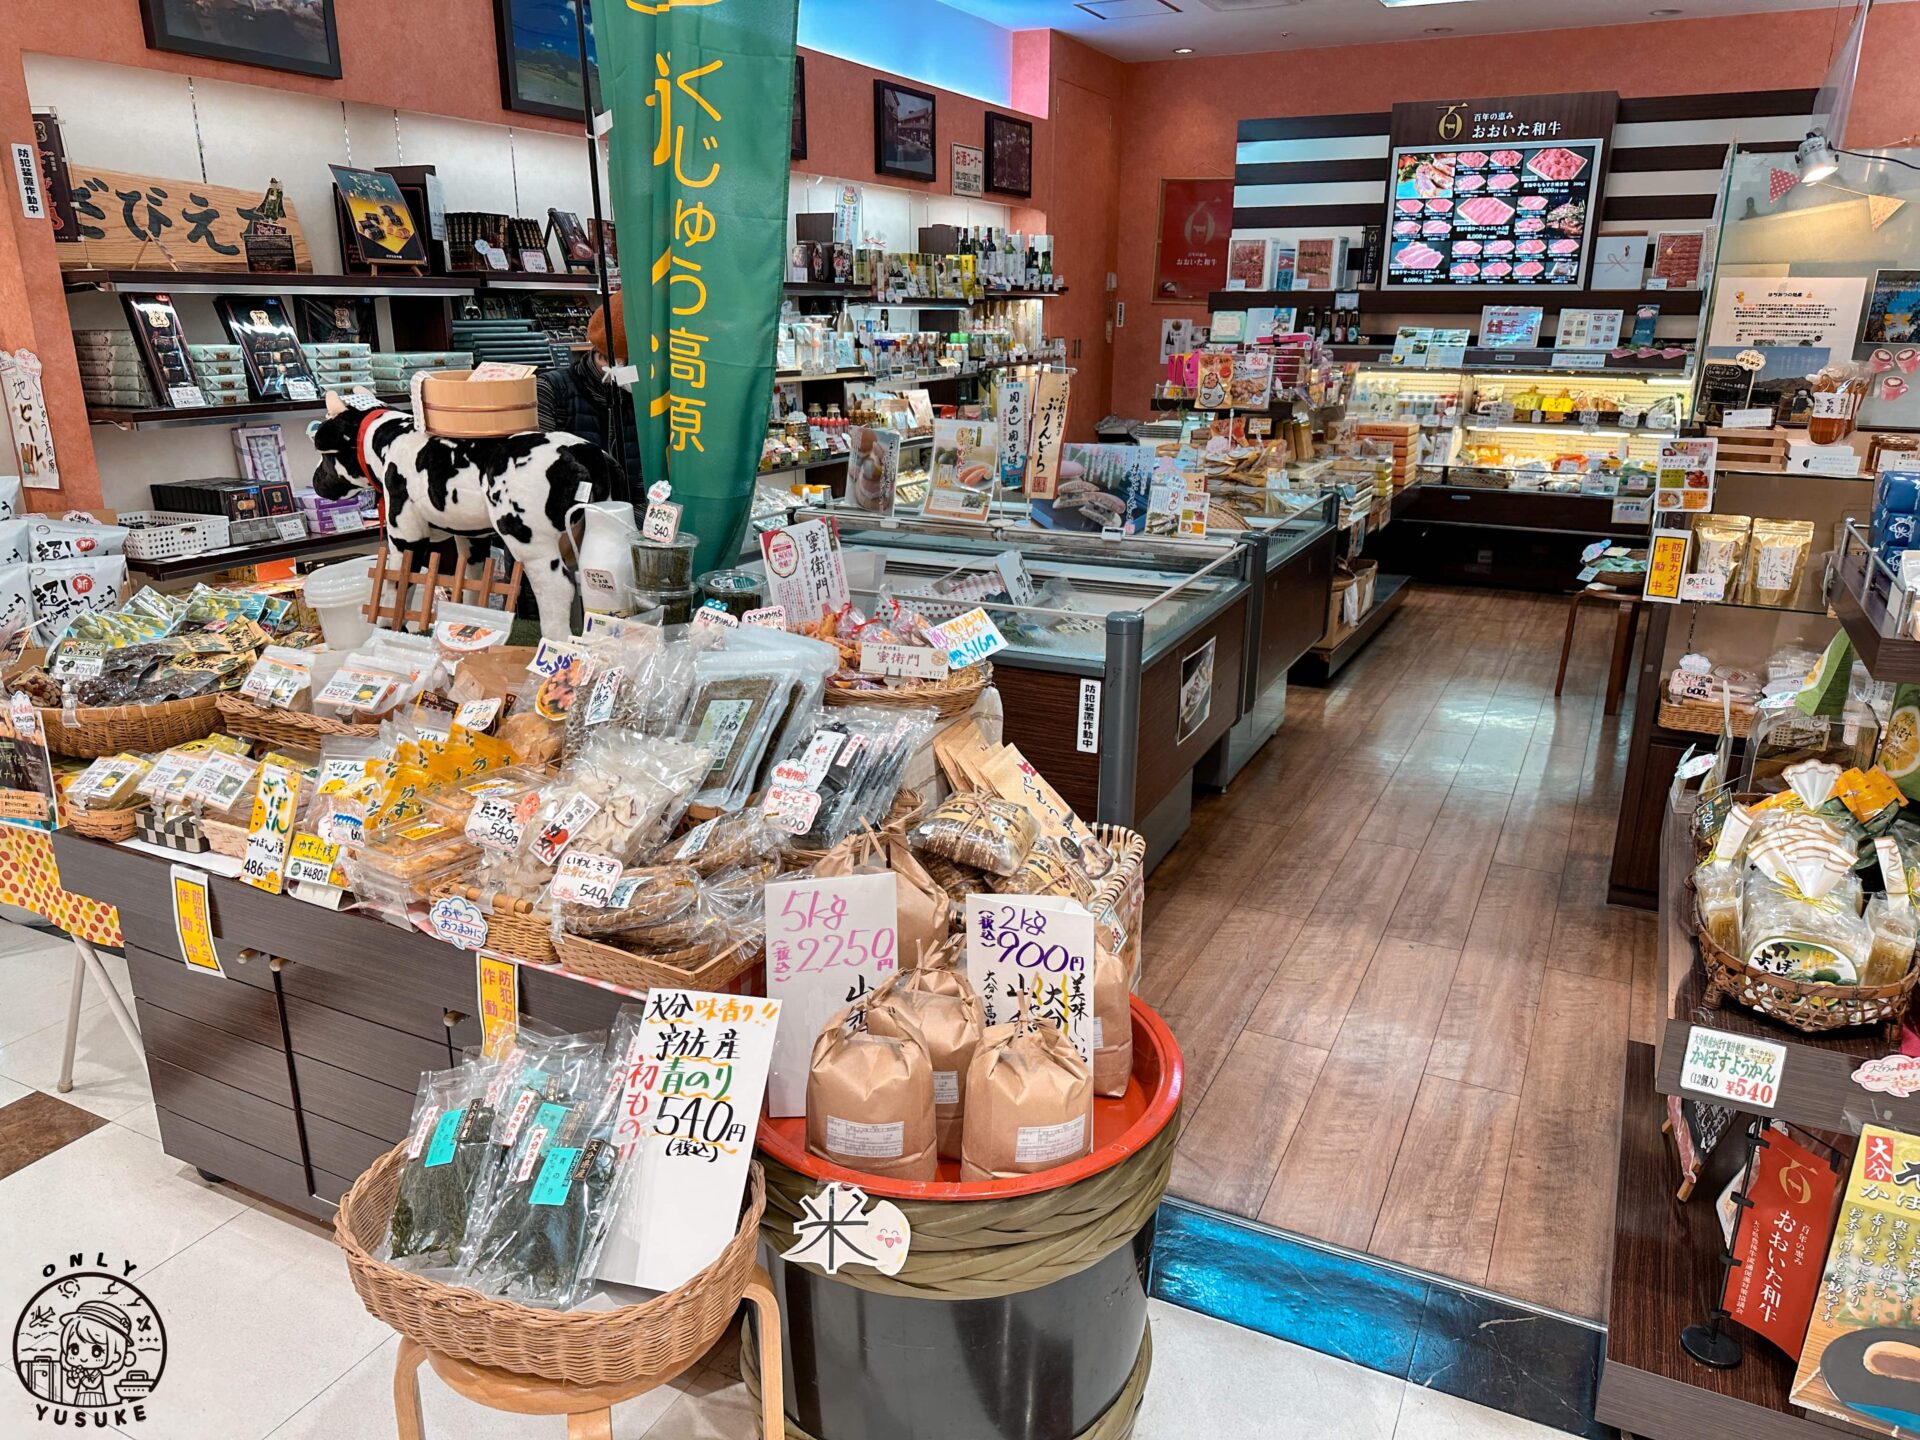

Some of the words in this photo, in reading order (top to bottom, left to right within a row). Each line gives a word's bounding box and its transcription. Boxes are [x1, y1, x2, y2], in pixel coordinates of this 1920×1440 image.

[1472, 121, 1561, 139] おおいた和牛
[1473, 112, 1514, 122] 百年の恵み
[17, 148, 39, 214] 防犯装置作動中
[669, 59, 724, 453] くじゅう高原
[805, 531, 831, 600] 蜜衛門
[1651, 543, 1667, 591] 作動中
[1665, 543, 1682, 592] 防犯カメラ
[877, 652, 920, 667] 蜜衛門
[1082, 684, 1096, 749] 防犯装置作動中
[490, 822, 519, 848] 540円
[179, 888, 199, 957] 作動中
[192, 889, 211, 962] 防犯カメラ
[440, 919, 483, 941] おつまみに
[441, 905, 475, 923] おやつ
[780, 889, 848, 932] 5kg
[998, 906, 1047, 935] 2kg
[997, 932, 1084, 973] 900円
[645, 993, 693, 1020] 大分
[656, 1023, 741, 1062] 宇佐産
[662, 1057, 733, 1100] 青のり
[1690, 1046, 1775, 1084] かぼすようかん
[1690, 1072, 1718, 1089] (12個入)
[1726, 1078, 1773, 1104] ¥540
[653, 1096, 746, 1143] 540円
[574, 1141, 600, 1180] 大分県産
[1866, 1137, 1893, 1182] 大分
[788, 1188, 879, 1270] 米
[1794, 1224, 1811, 1266] 百年の恵み
[1759, 1210, 1796, 1323] おおいた和牛
[1849, 1213, 1886, 1307] 香りがお口に広がり
[1874, 1218, 1910, 1301] 爽やかなかぼすの
